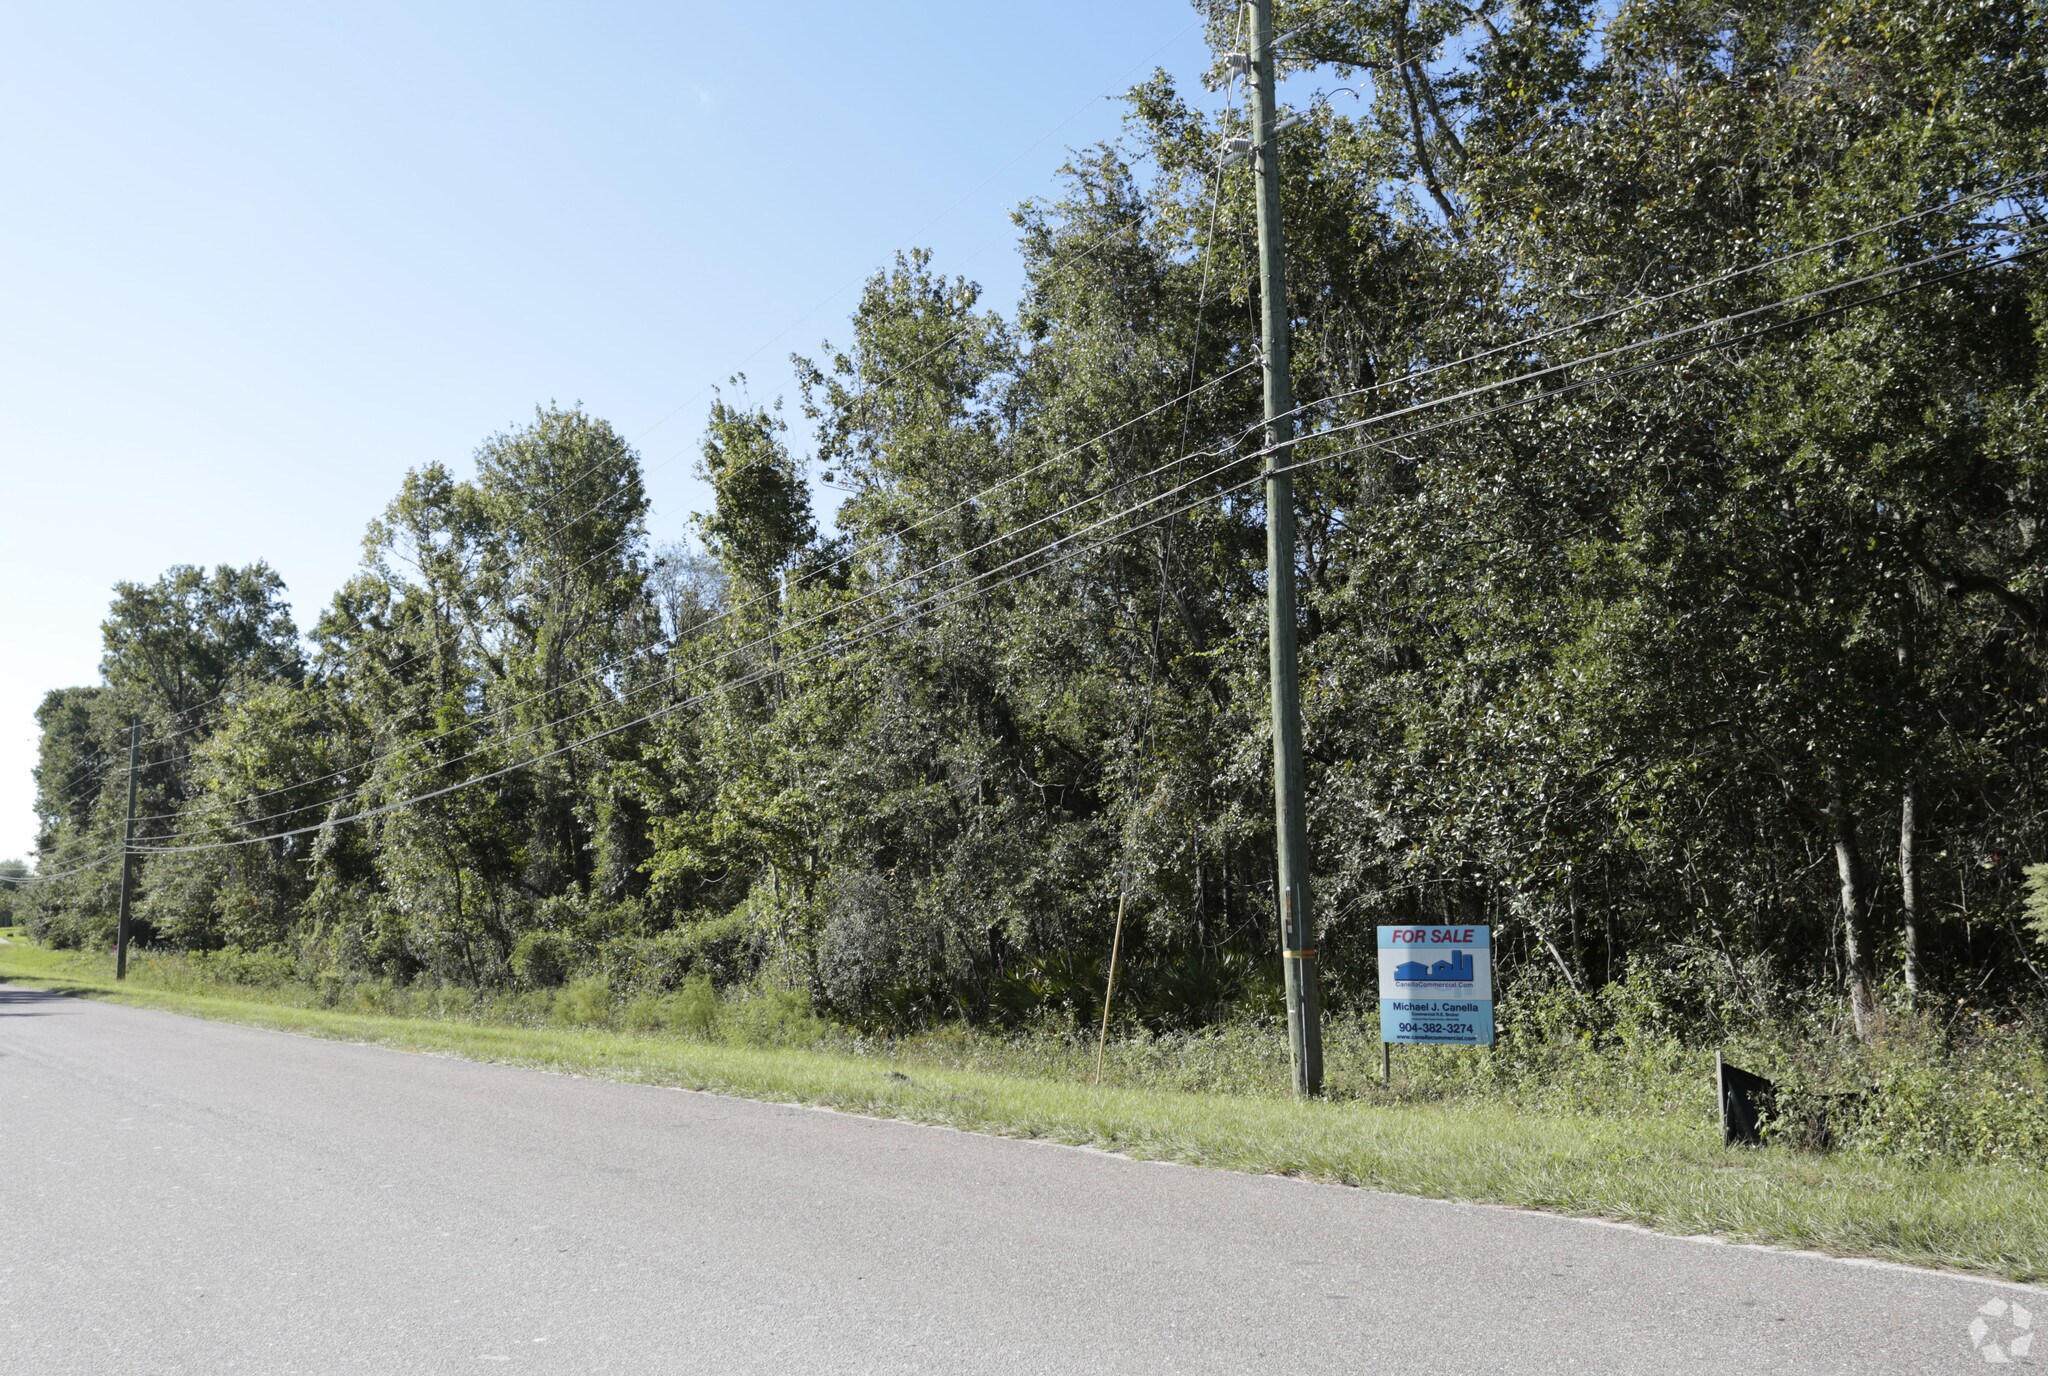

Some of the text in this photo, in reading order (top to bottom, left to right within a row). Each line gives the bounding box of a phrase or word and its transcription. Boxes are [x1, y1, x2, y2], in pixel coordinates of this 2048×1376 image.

[1392, 930, 1474, 943] FOR SALE
[1393, 1002, 1428, 1011] Michael
[1443, 1003, 1478, 1012] Canella
[1399, 1022, 1474, 1034] 904-382-3274
